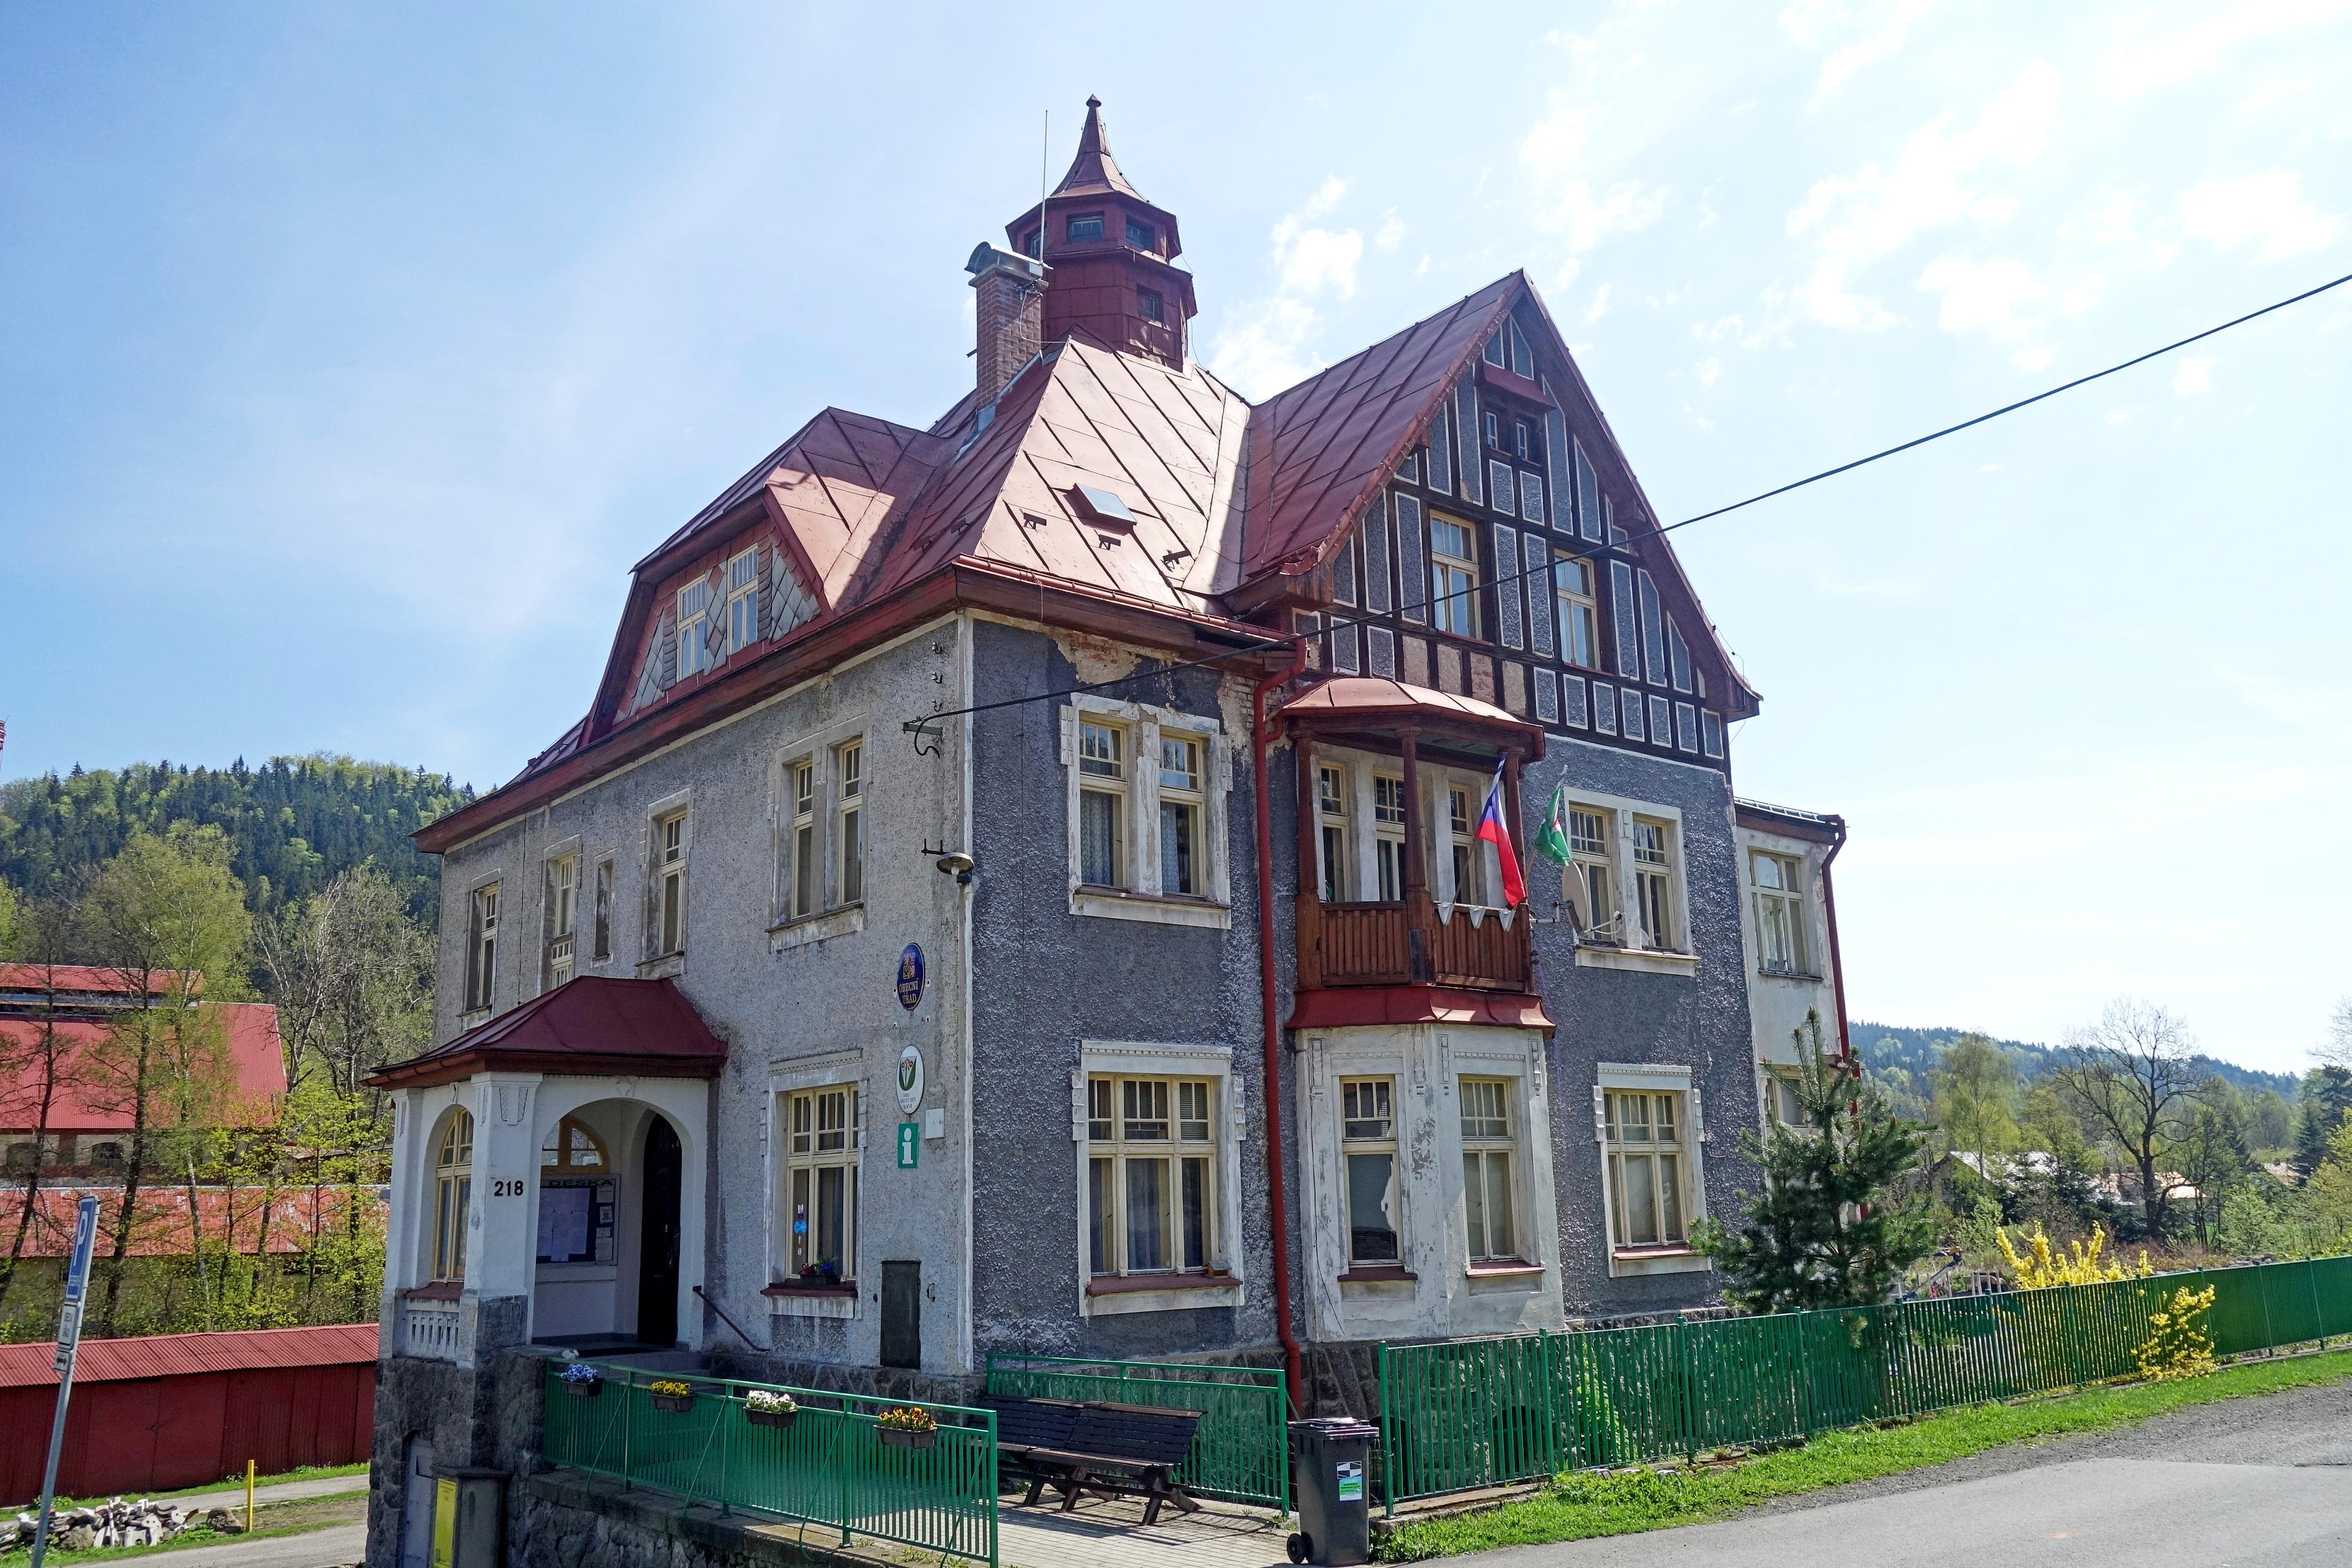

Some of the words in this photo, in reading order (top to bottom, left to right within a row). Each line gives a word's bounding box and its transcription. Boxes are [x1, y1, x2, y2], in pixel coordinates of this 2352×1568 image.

[899, 978, 918, 993] OBECNÍ
[903, 992, 916, 1004] ÚŘAD
[494, 1180, 523, 1196] 218
[73, 1211, 88, 1268] P
